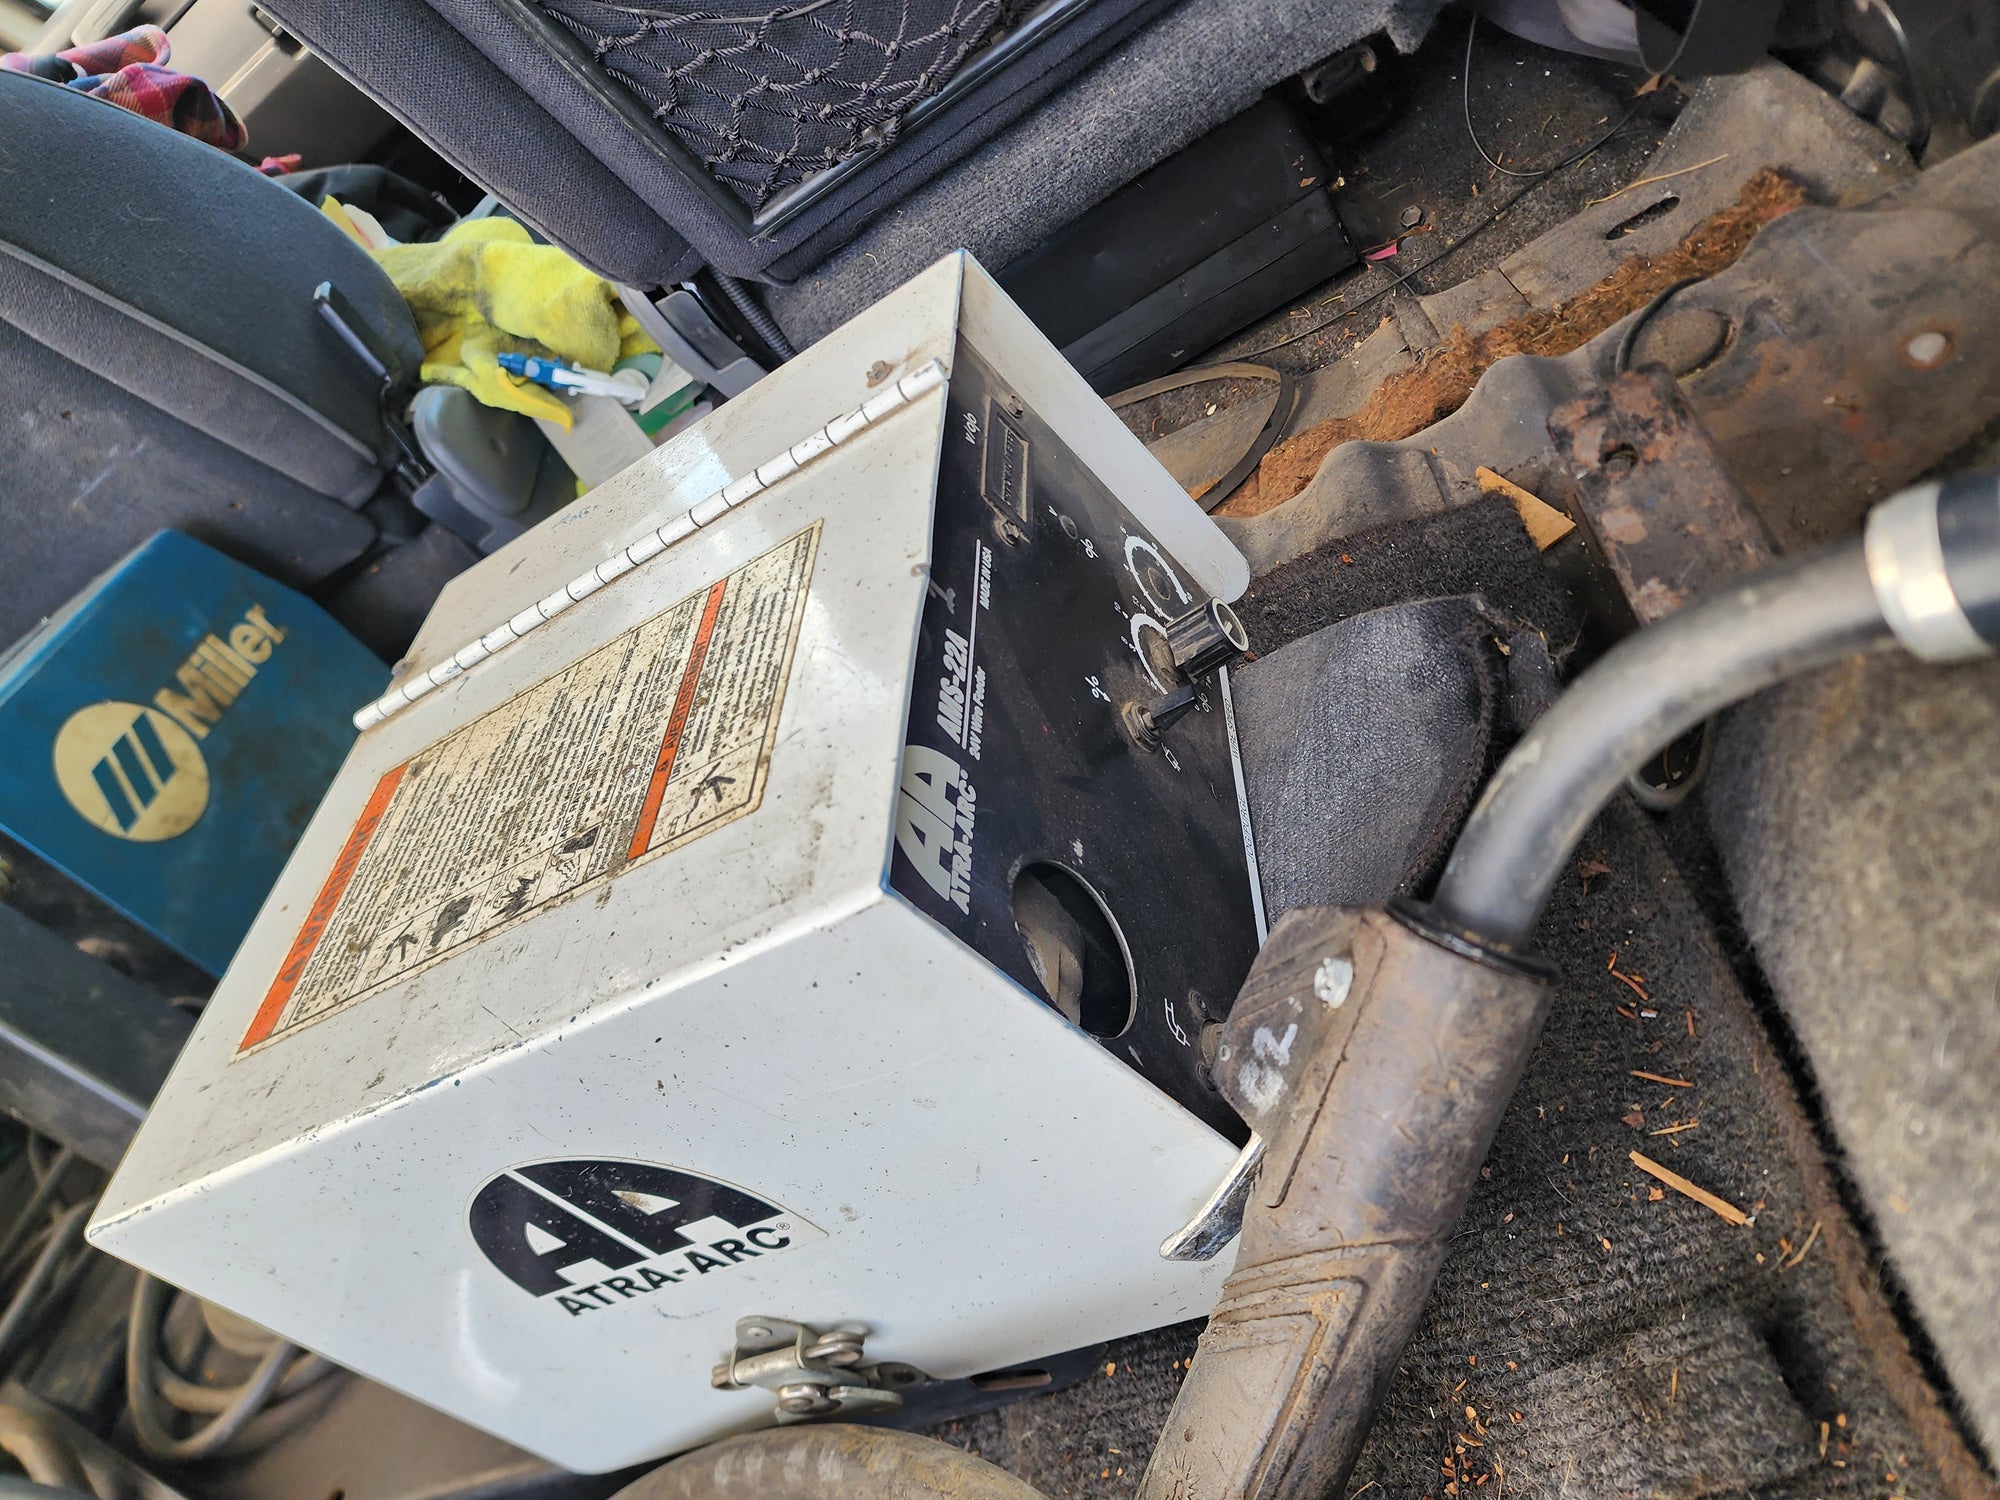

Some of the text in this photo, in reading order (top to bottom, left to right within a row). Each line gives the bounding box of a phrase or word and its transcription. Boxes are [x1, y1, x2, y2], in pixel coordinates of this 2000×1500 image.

[979, 547, 993, 610] MADE IN USA
[154, 602, 286, 740] Miller
[662, 636, 708, 752] AVERTISSEMENT
[936, 627, 969, 745] AMS-22A
[675, 728, 693, 762] CHOC
[968, 733, 982, 761] 24V
[970, 706, 984, 736] Wire
[1224, 698, 1239, 760] WIRE SPEED
[567, 781, 586, 813] RAYS
[595, 714, 611, 739] eyes
[444, 858, 468, 898] FUMES
[472, 796, 494, 834] GASES
[497, 817, 526, 871] WELDING
[1237, 795, 1256, 864] JOG/PURGE
[295, 811, 383, 959] WARNING
[303, 941, 337, 996] WELDING
